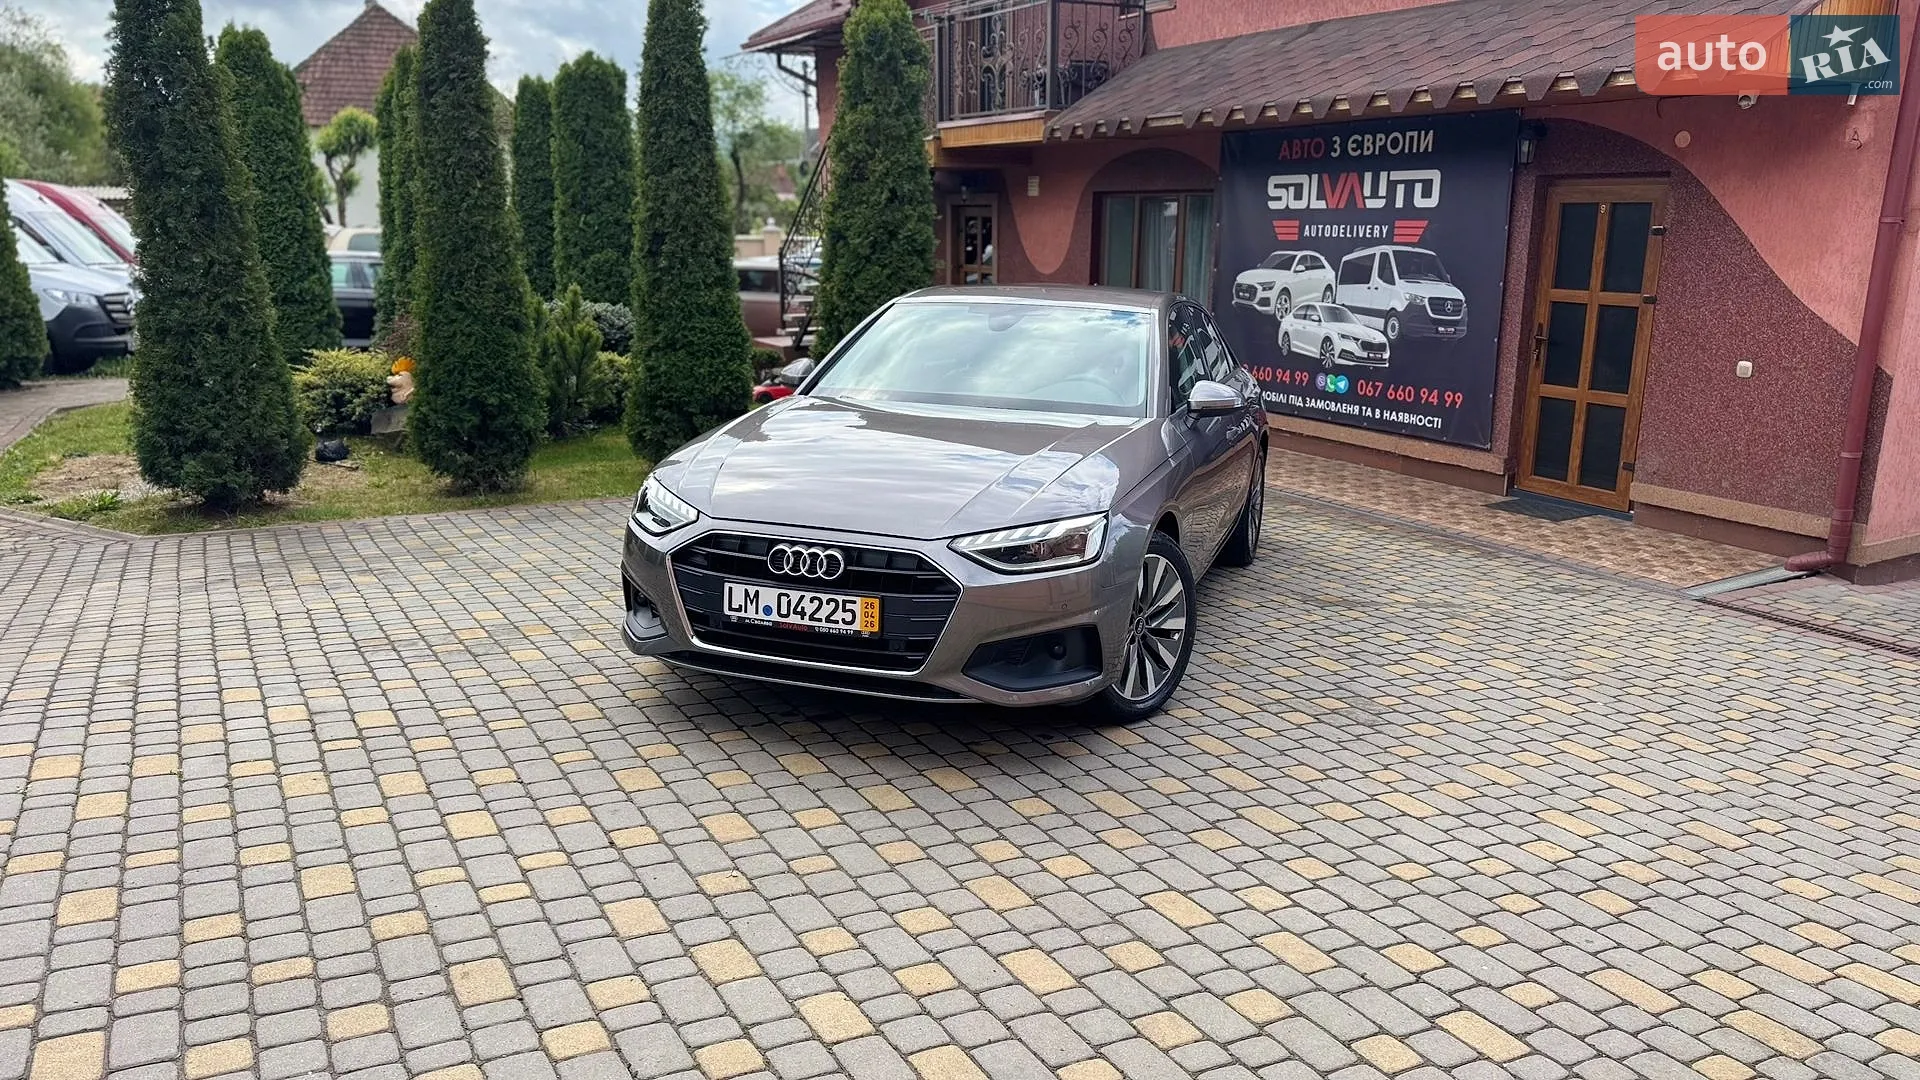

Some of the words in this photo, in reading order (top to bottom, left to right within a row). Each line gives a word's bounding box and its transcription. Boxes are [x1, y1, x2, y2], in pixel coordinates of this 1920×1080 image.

[1279, 138, 1325, 160] АВТО
[1331, 136, 1341, 158] З
[1347, 130, 1434, 156] ЄВРОПИ
[1267, 169, 1442, 210] SOLVAUTO
[1304, 224, 1389, 239] AUTODELIVERY
[1276, 368, 1291, 384] 94
[1295, 370, 1309, 387] 99
[1357, 379, 1384, 398] 067
[1387, 384, 1414, 402] 660
[1420, 388, 1439, 405] 94
[1444, 391, 1464, 409] 99
[1288, 394, 1304, 408] ПІД
[1305, 399, 1360, 417] ЗАМОВЛЕНЯ
[1361, 406, 1373, 418] ТА
[1375, 408, 1381, 419] В
[1383, 409, 1442, 429] НАЯВНОСТІ
[728, 586, 760, 615] LM
[776, 592, 857, 626] 04225
[864, 601, 875, 610] 26
[864, 611, 875, 619] 04
[864, 620, 875, 628] 26
